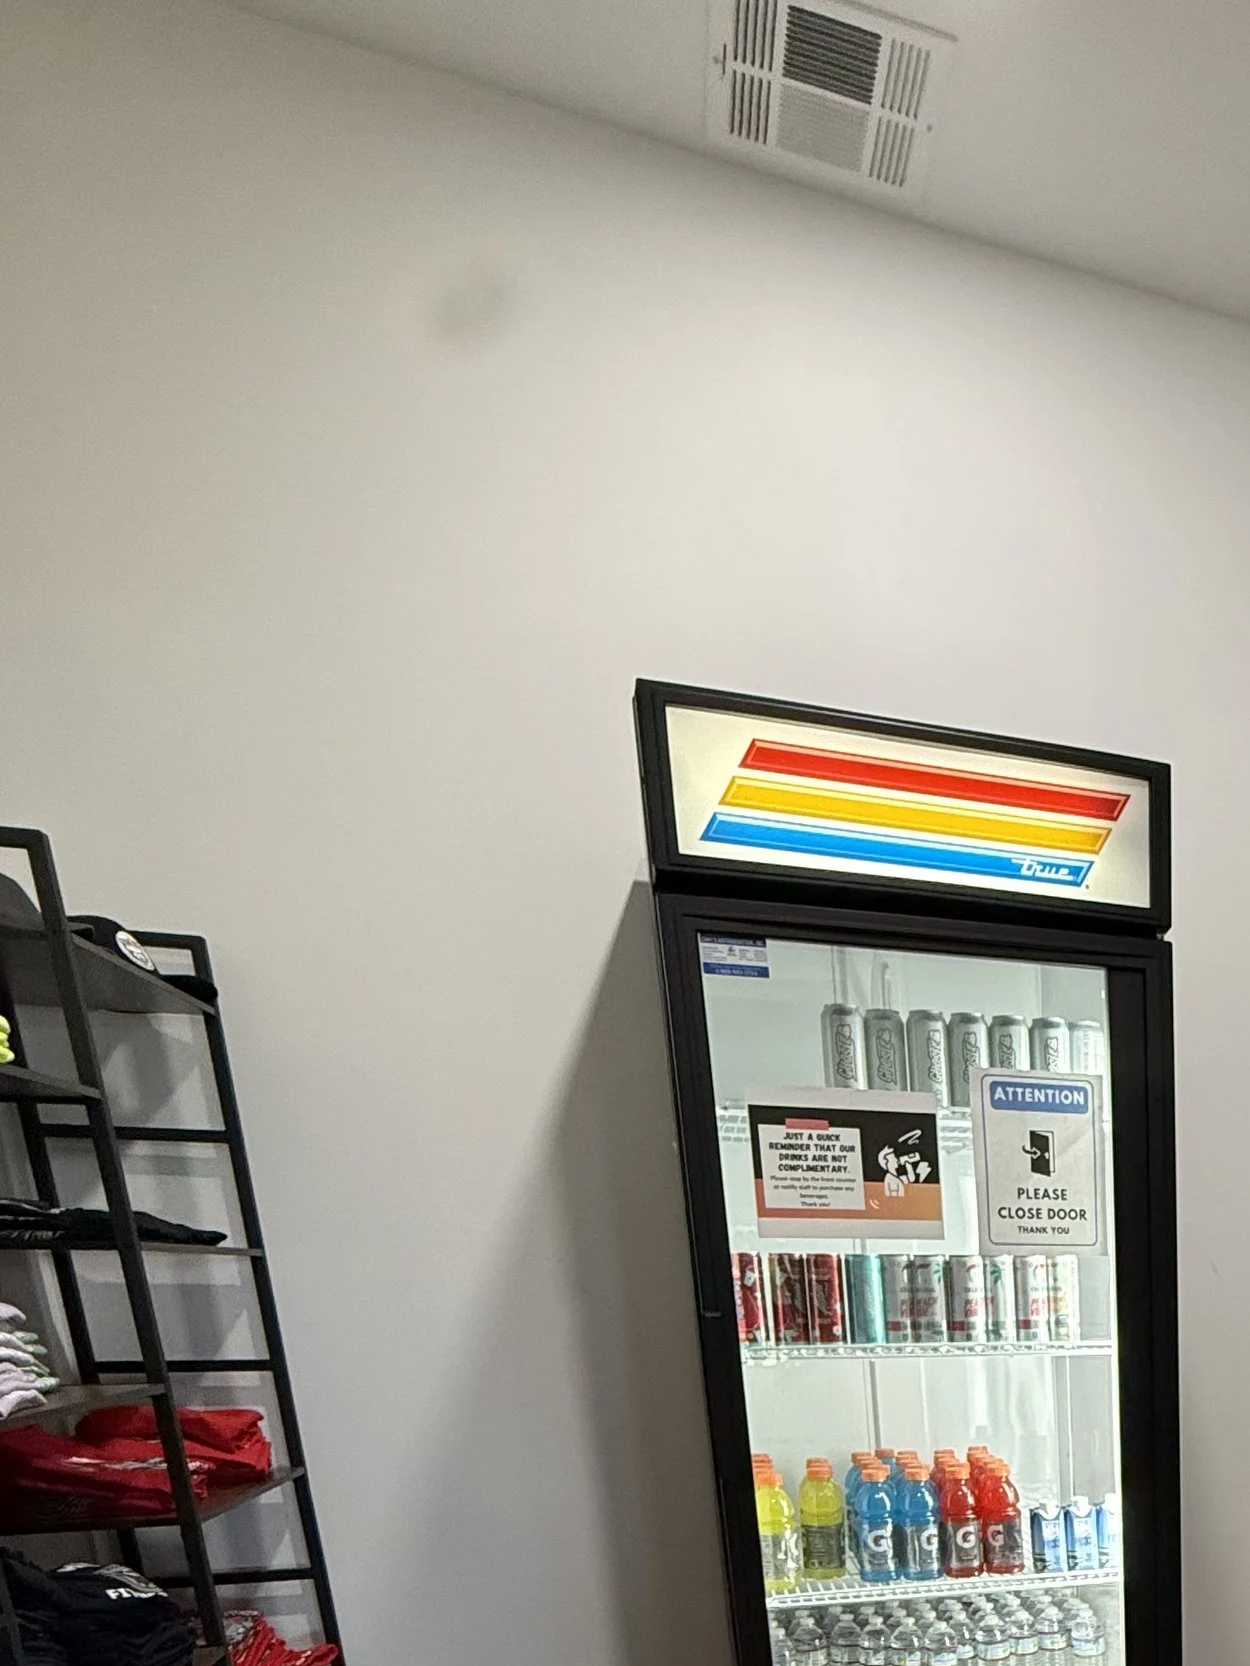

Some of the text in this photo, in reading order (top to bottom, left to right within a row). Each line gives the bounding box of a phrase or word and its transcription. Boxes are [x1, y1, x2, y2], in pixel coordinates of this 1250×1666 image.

[1011, 858, 1076, 881] True
[994, 1087, 1085, 1105] ATTENTION
[783, 1132, 841, 1142] JUST A QUICK
[768, 1142, 856, 1153] REMINDER THAT OUR
[778, 1153, 847, 1163] DRINKS ARE NOT
[1017, 1188, 1068, 1201] PLEASE
[998, 1207, 1088, 1221] CLOSE DOOR
[1018, 1226, 1070, 1235] THANK YOU
[867, 1530, 888, 1552] G
[921, 1530, 939, 1551] G
[955, 1526, 977, 1548] G
[987, 1525, 1004, 1547] G
